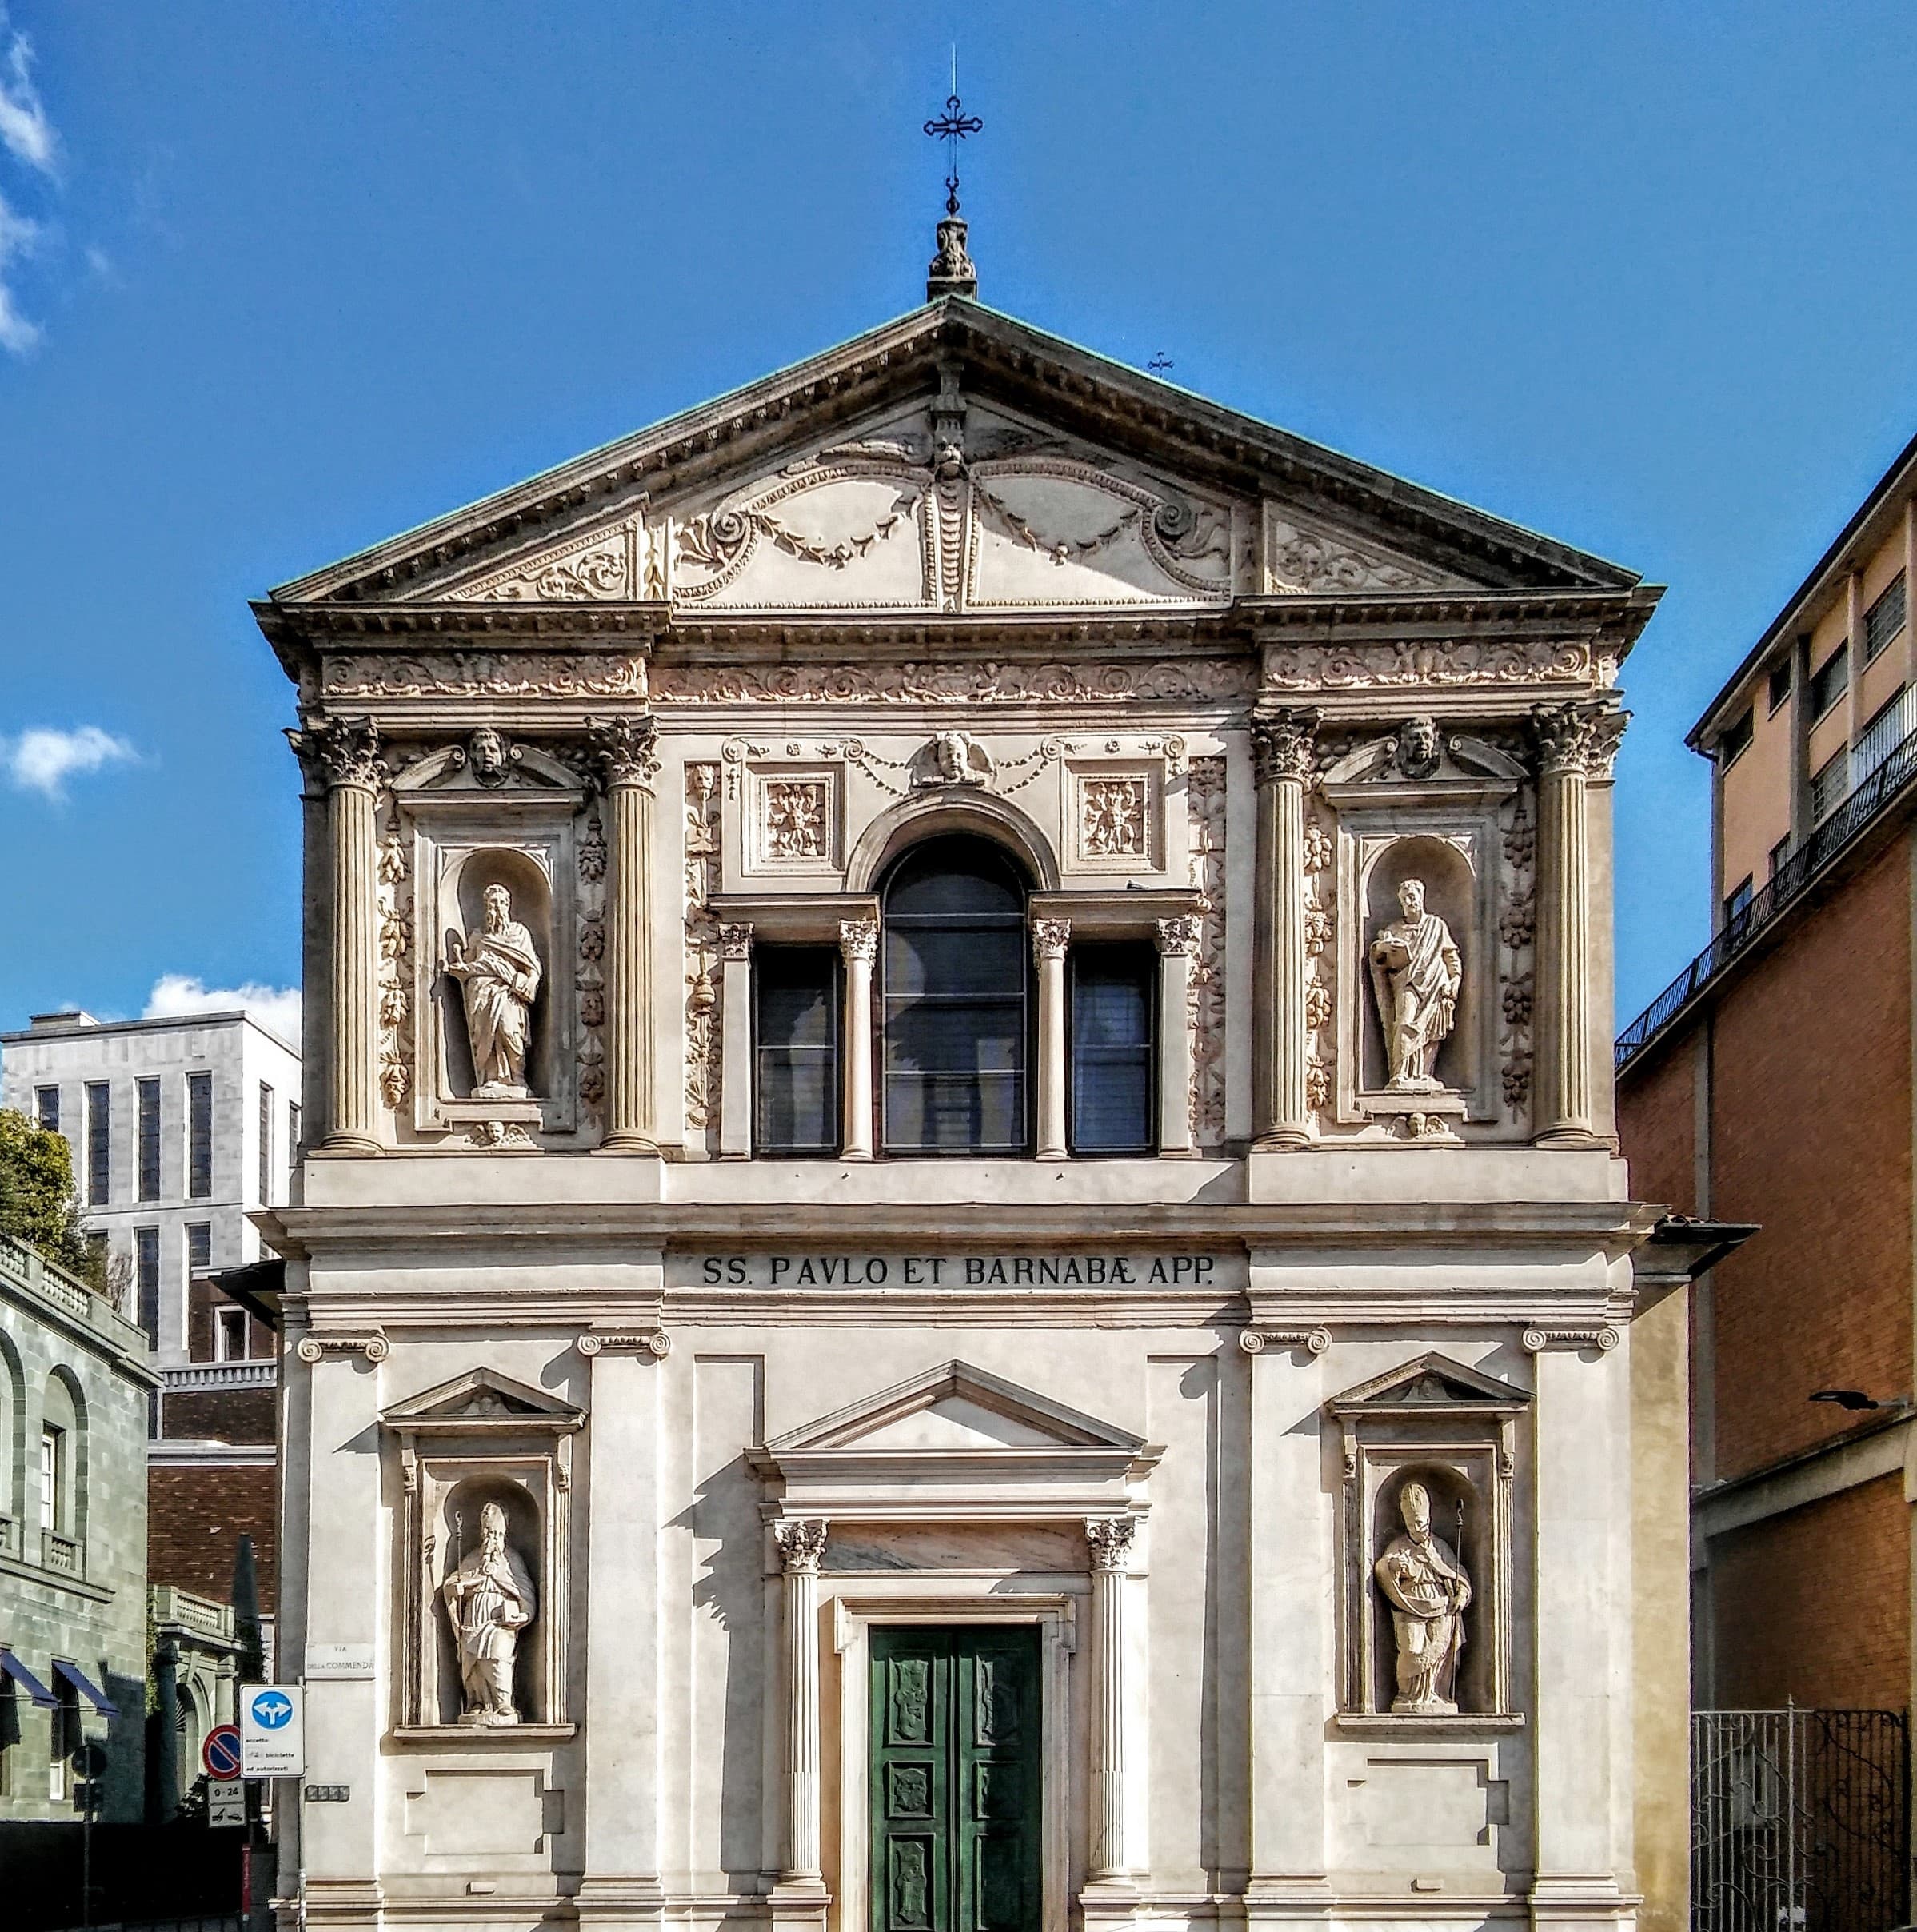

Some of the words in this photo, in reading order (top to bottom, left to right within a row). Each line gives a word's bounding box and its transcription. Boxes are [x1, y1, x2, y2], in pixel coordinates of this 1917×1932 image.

[703, 1257, 753, 1285] SS.
[770, 1257, 888, 1285] PAVLO
[903, 1257, 948, 1285] ET
[1148, 1256, 1215, 1285] APP.
